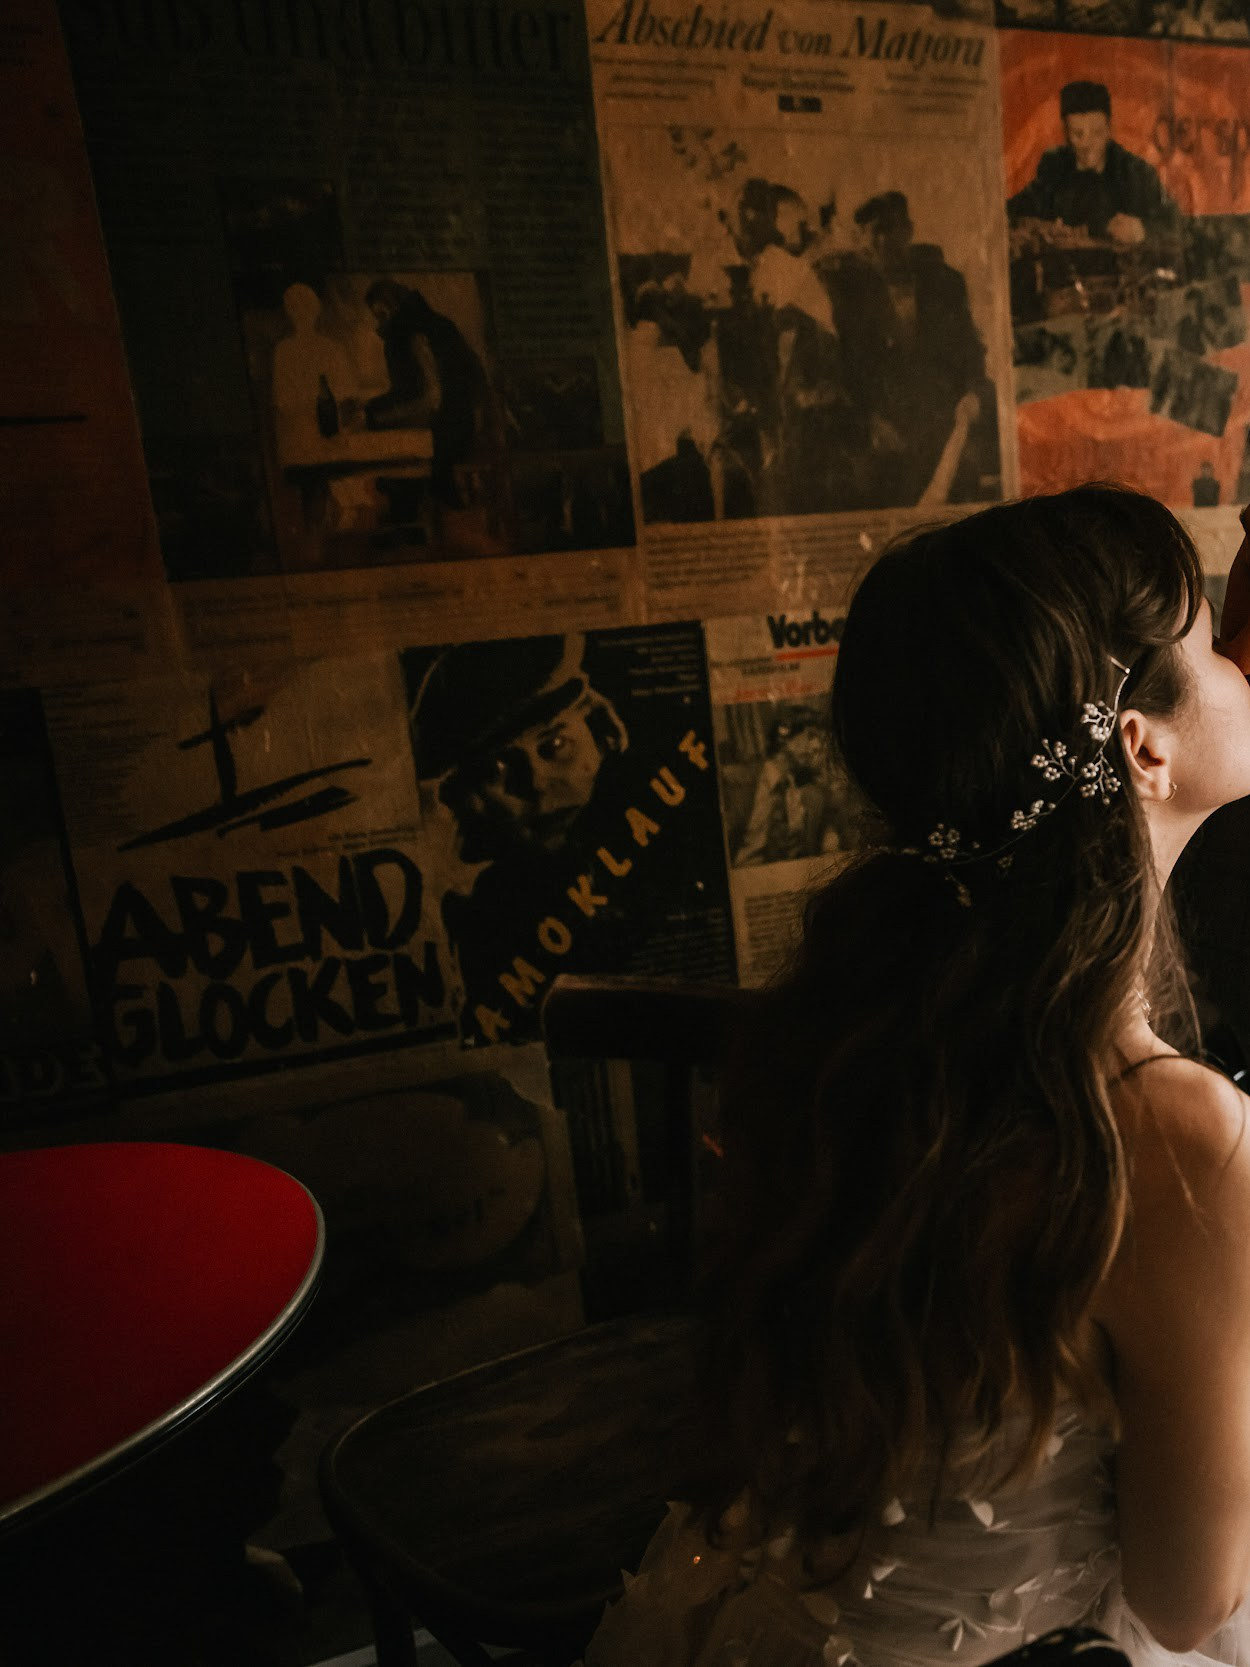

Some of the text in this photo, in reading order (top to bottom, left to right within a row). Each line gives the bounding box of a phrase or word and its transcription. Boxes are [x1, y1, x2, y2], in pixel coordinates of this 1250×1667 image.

[595, 0, 773, 53] Abschied
[777, 29, 832, 55] von
[95, 849, 423, 980] ABEND
[475, 730, 713, 1044] AMOKLAUF
[104, 943, 446, 1066] GLOCKEN
